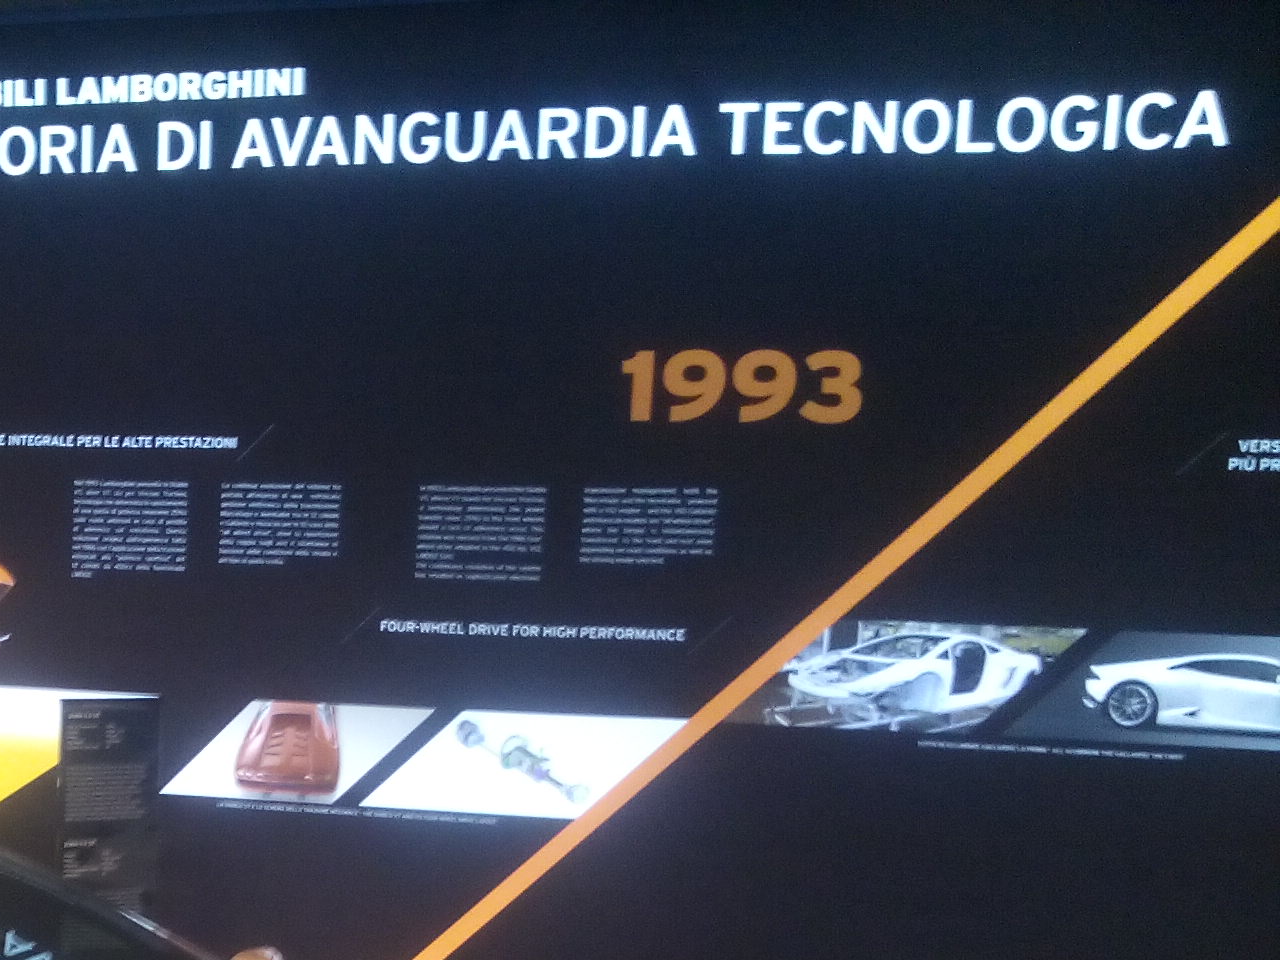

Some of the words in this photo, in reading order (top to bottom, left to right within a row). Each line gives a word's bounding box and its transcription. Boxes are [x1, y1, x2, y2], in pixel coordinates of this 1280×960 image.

[55, 66, 307, 106] LAMBORGHINI
[156, 119, 214, 172] DI
[230, 104, 698, 169] AVANGUARDIA
[718, 89, 1229, 156] TECNOLOGICA
[621, 348, 863, 424] 1993
[8, 433, 75, 448] INTEGRALE
[77, 434, 102, 448] PER
[104, 435, 120, 448] LE
[122, 435, 153, 449] ALTE
[155, 435, 238, 449] PRESTAZIONI
[1227, 455, 1258, 473] PIÙ
[380, 619, 465, 636] FOUR-WHEEL
[468, 622, 510, 637] DRIVE
[512, 623, 540, 638] FOR
[543, 624, 578, 639] HIGH
[579, 625, 686, 642] PERFORMANCE
